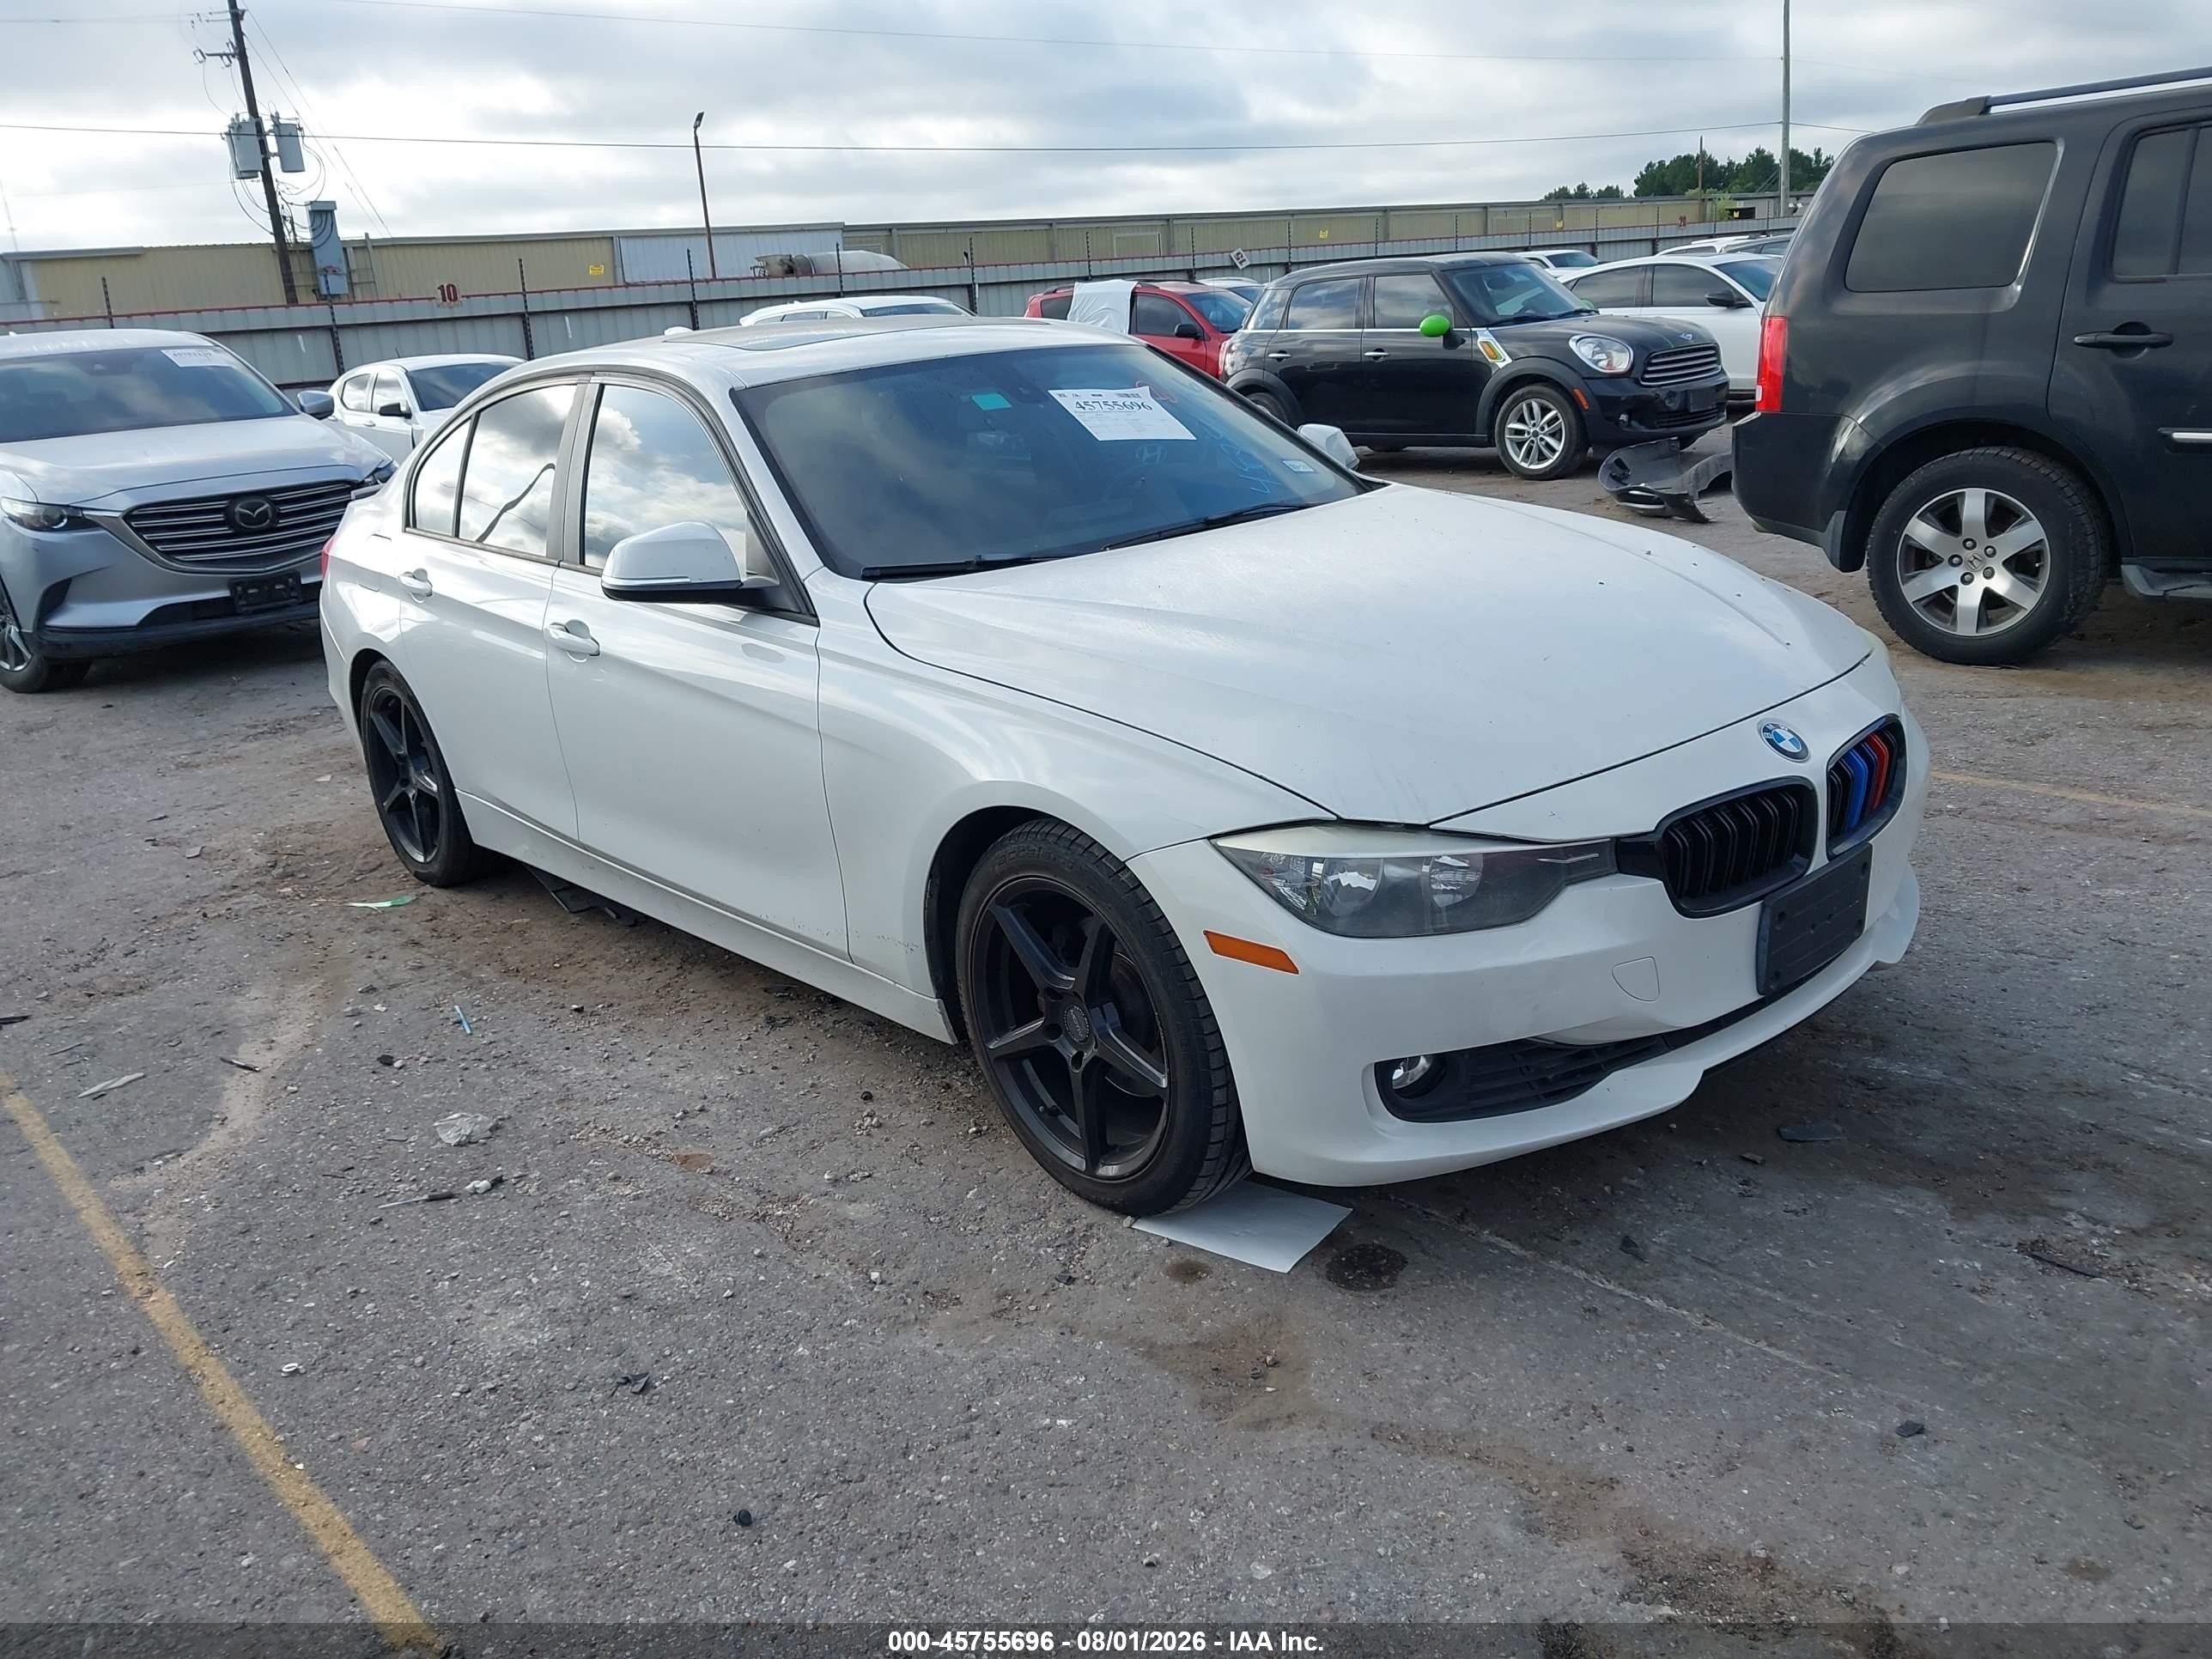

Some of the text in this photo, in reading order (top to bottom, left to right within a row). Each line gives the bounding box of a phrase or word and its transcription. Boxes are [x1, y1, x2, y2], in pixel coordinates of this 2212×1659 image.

[1233, 252, 1246, 266] 15
[437, 283, 458, 302] 10
[1075, 400, 1153, 411] 45755696
